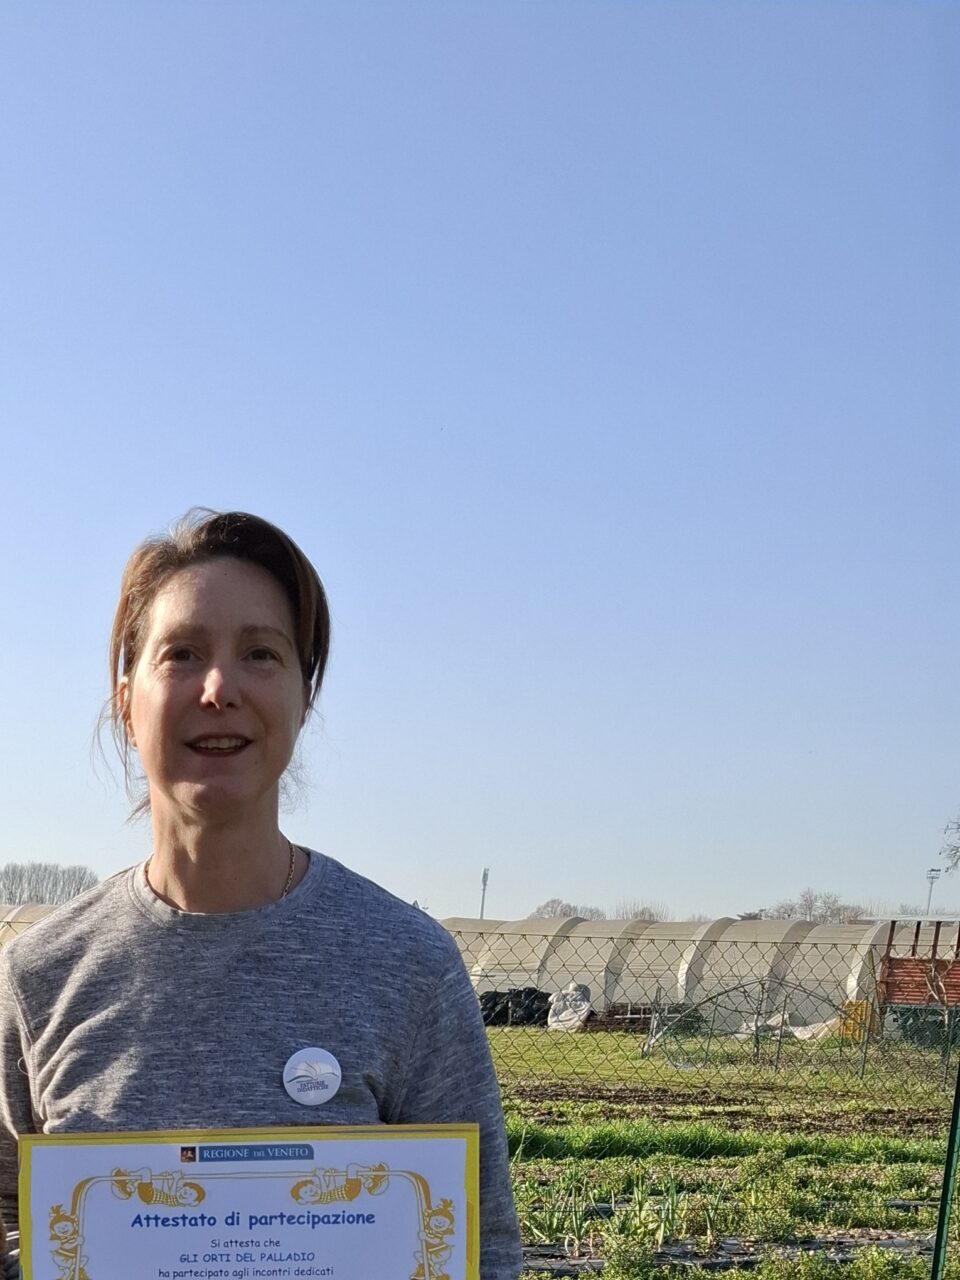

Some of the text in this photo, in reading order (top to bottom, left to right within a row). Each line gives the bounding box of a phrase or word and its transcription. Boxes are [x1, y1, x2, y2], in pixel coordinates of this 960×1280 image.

[203, 1148, 249, 1158] REGIONE
[267, 1147, 309, 1157] VENETO
[131, 1210, 376, 1230] Attestato di partecipazione
[210, 1238, 281, 1248] Si attesta che
[179, 1252, 315, 1263] GLI ORTI DEL PALLADIO
[158, 1266, 334, 1280] ha partecipato agli incontri dedicati
